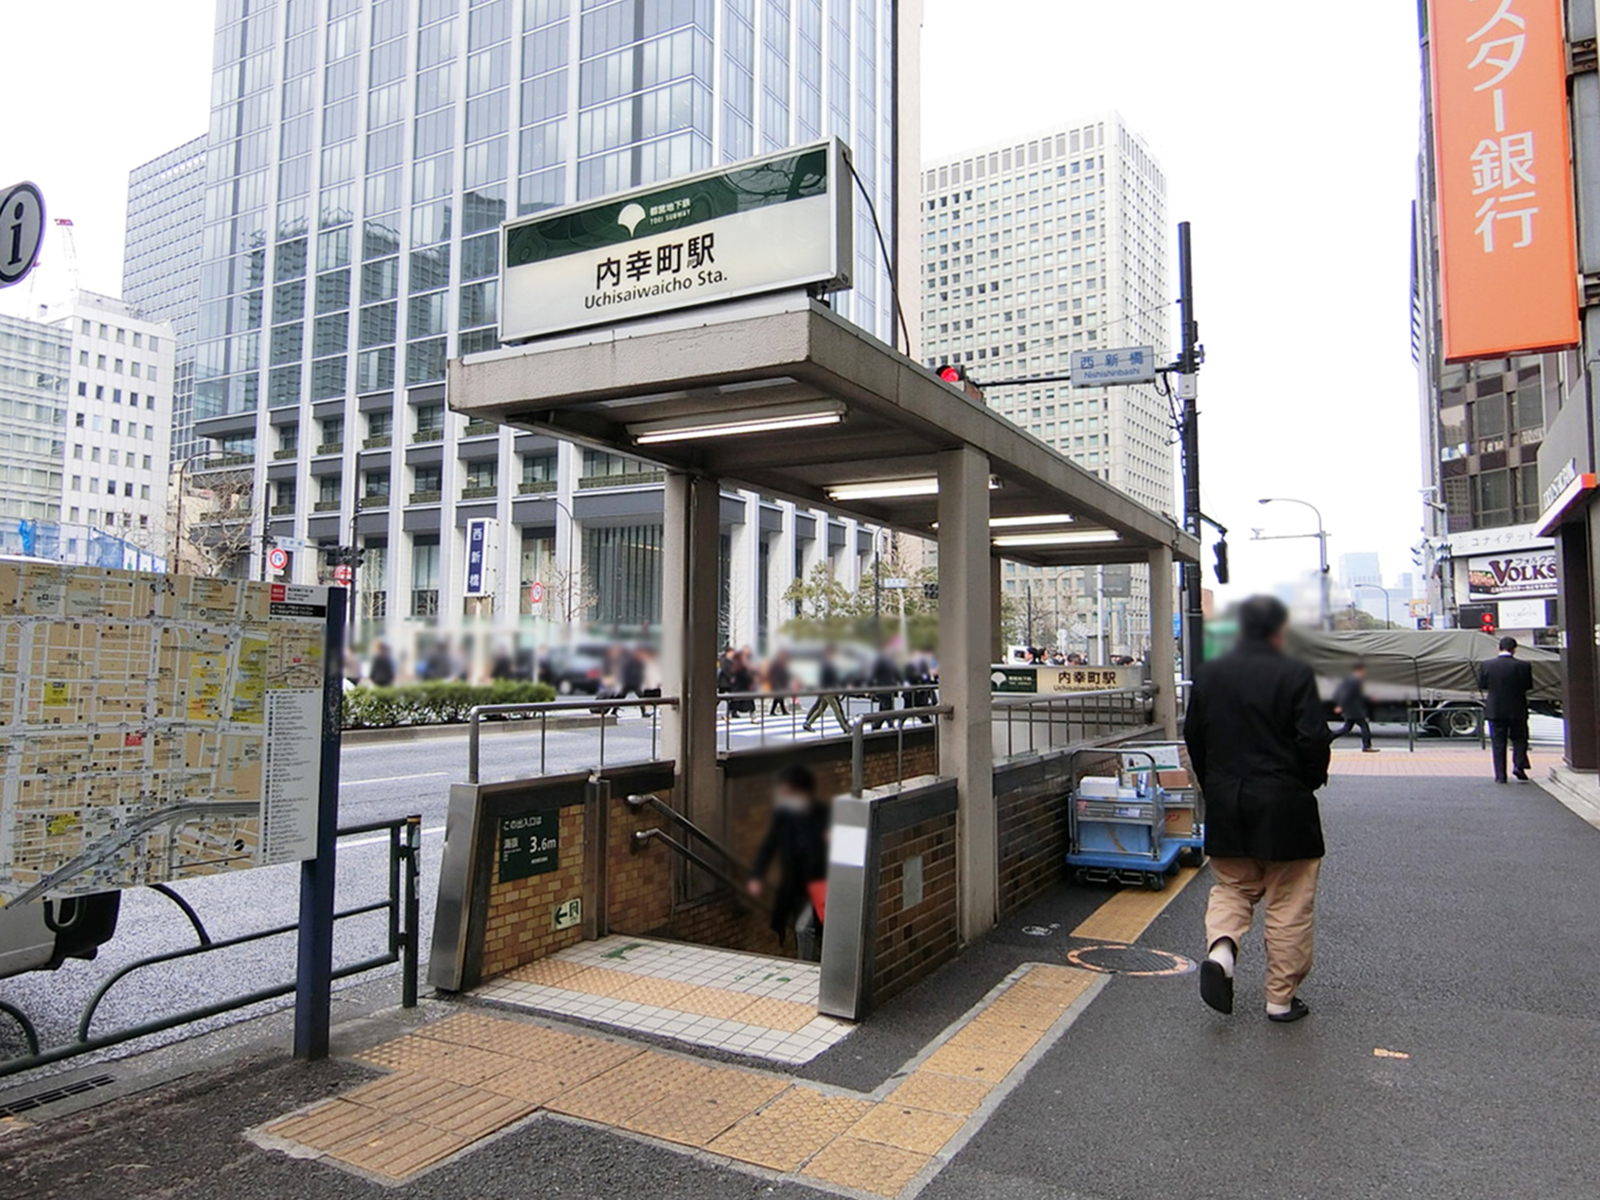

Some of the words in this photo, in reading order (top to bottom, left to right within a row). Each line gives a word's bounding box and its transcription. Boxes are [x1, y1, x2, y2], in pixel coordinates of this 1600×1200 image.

[596, 233, 715, 290] 内幸町駅
[584, 276, 693, 310] Uchisaiwaicho
[697, 269, 728, 287] Sta.
[1080, 350, 1144, 370] 西新橋
[1083, 367, 1141, 379] Nishishinbashi
[469, 527, 483, 587] 西新橋
[1488, 559, 1557, 585] VOLKS
[1058, 671, 1117, 685] 内幸町駅
[529, 836, 557, 853] 3.6m
